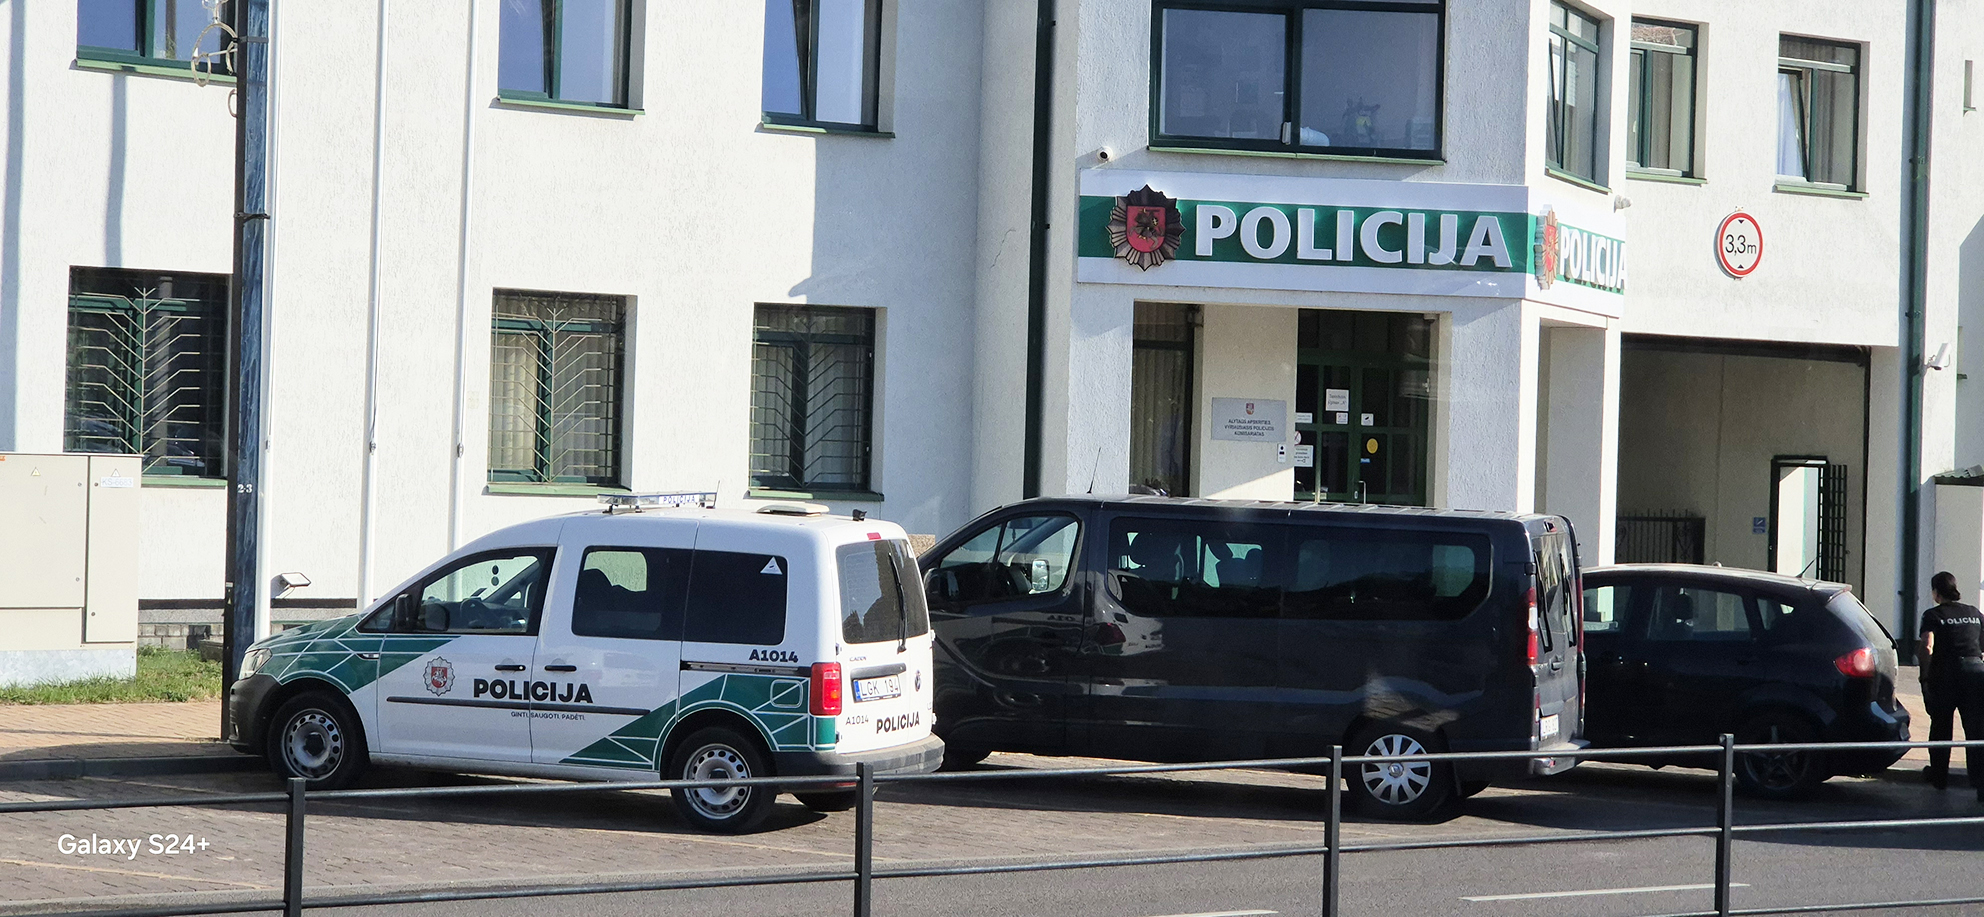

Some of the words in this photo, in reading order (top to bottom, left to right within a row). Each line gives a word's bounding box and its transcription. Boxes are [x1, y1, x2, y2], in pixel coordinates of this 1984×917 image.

[1195, 203, 1513, 268] POLICIJA
[1560, 225, 1627, 290] POLICIJA
[663, 495, 695, 504] POLICIJA
[749, 648, 799, 663] A1014
[473, 678, 594, 704] POLICIJA
[860, 680, 880, 696] LGK
[884, 679, 899, 693] 194
[845, 715, 869, 725] A1014
[876, 711, 920, 734] POLICIJA
